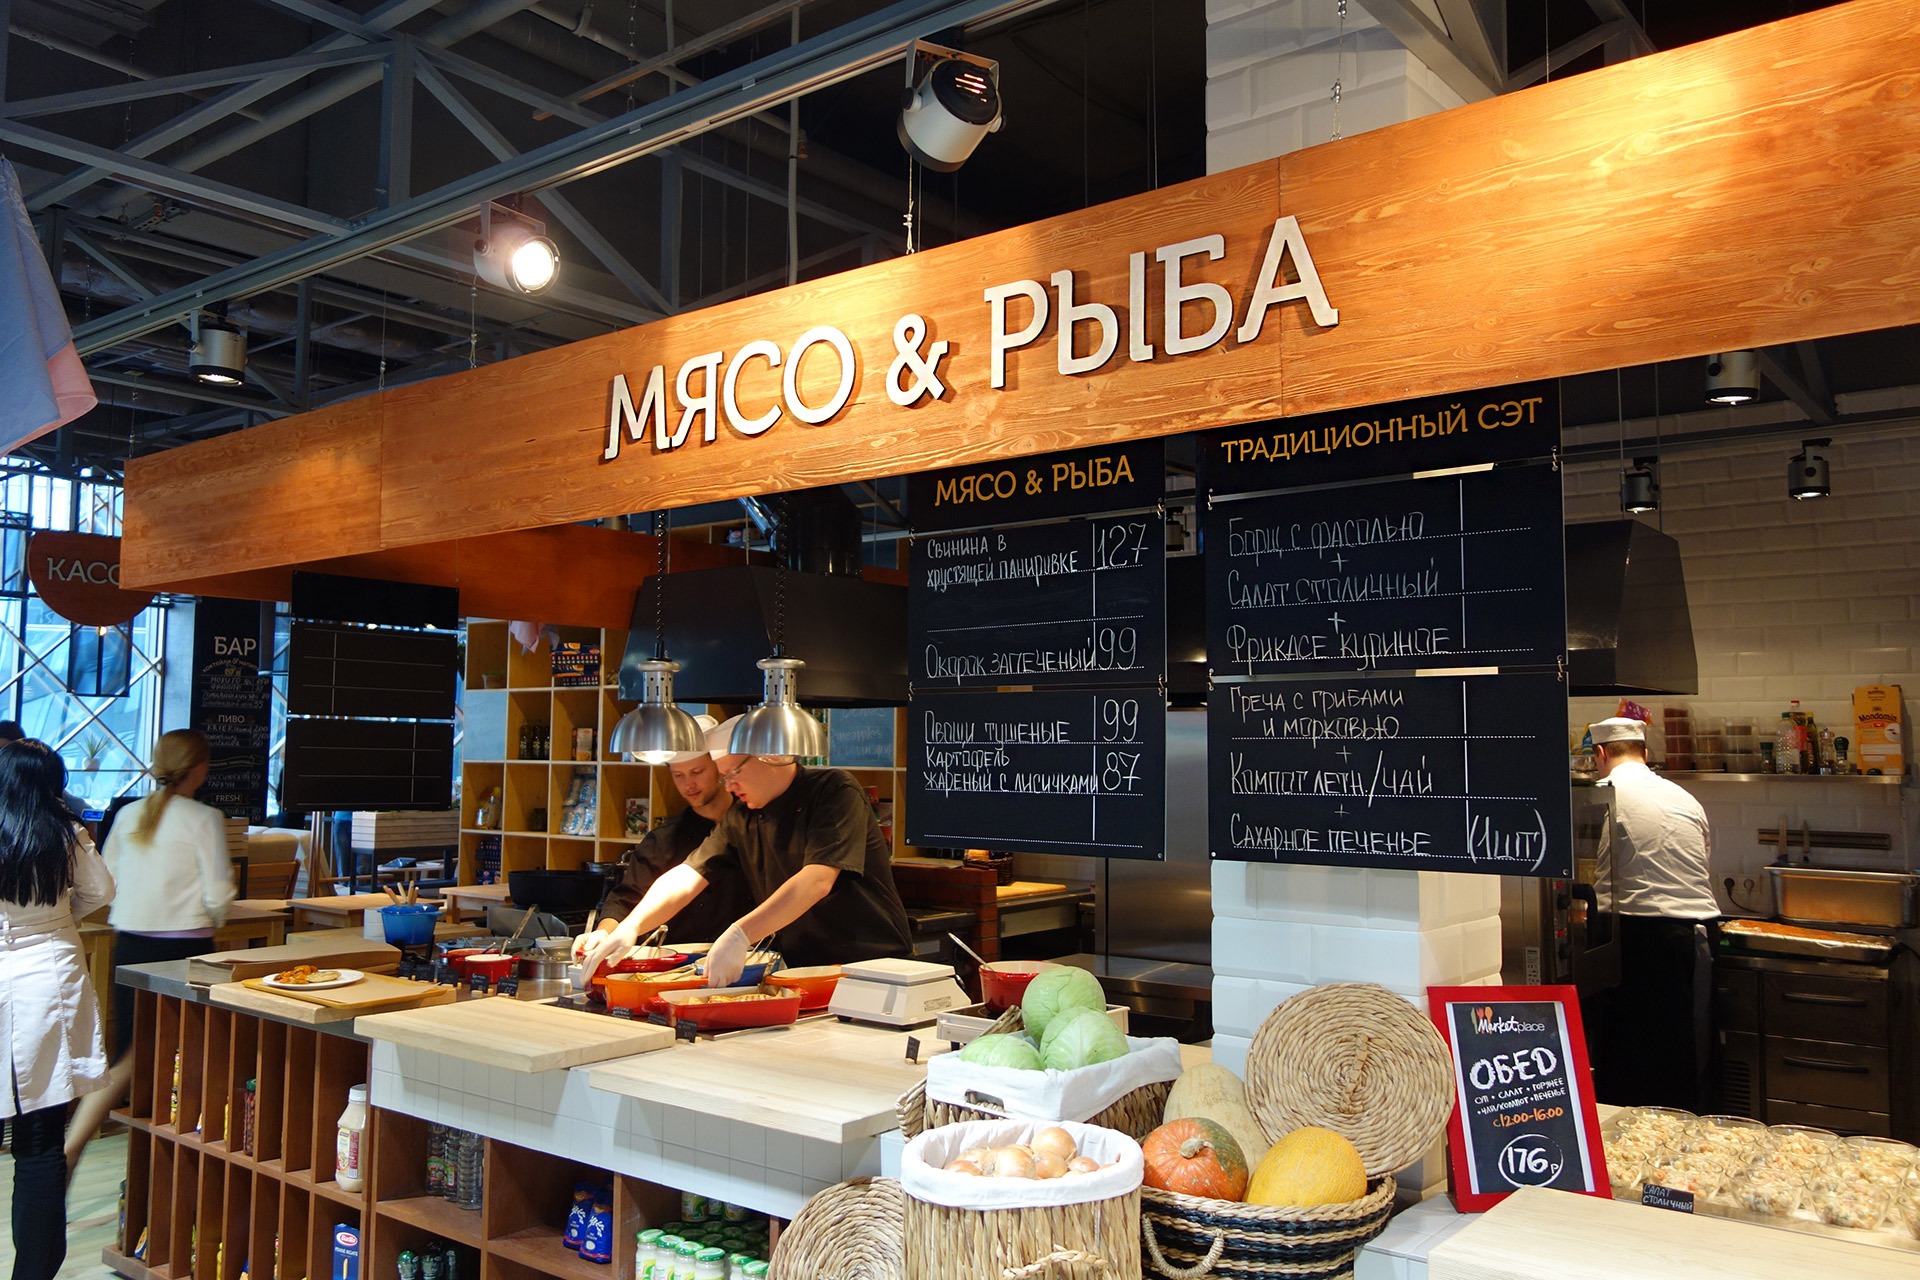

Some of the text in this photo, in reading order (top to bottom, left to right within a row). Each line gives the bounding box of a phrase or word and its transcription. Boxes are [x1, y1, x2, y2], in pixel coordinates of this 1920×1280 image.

[605, 215, 1339, 460] МЯСО & РЫБА
[1221, 397, 1543, 463] ТРАДИЦИОННЫЙ СЭТ
[935, 455, 1134, 507] МЯСО & РЫБА
[1096, 522, 1149, 571] 127
[214, 636, 257, 656] БАР
[1099, 627, 1137, 670] 99
[218, 714, 246, 724] ПИВО
[1102, 699, 1139, 742] 99
[1102, 752, 1141, 791] 87
[215, 794, 241, 803] FRESH
[1469, 1047, 1557, 1090] ОБЕД
